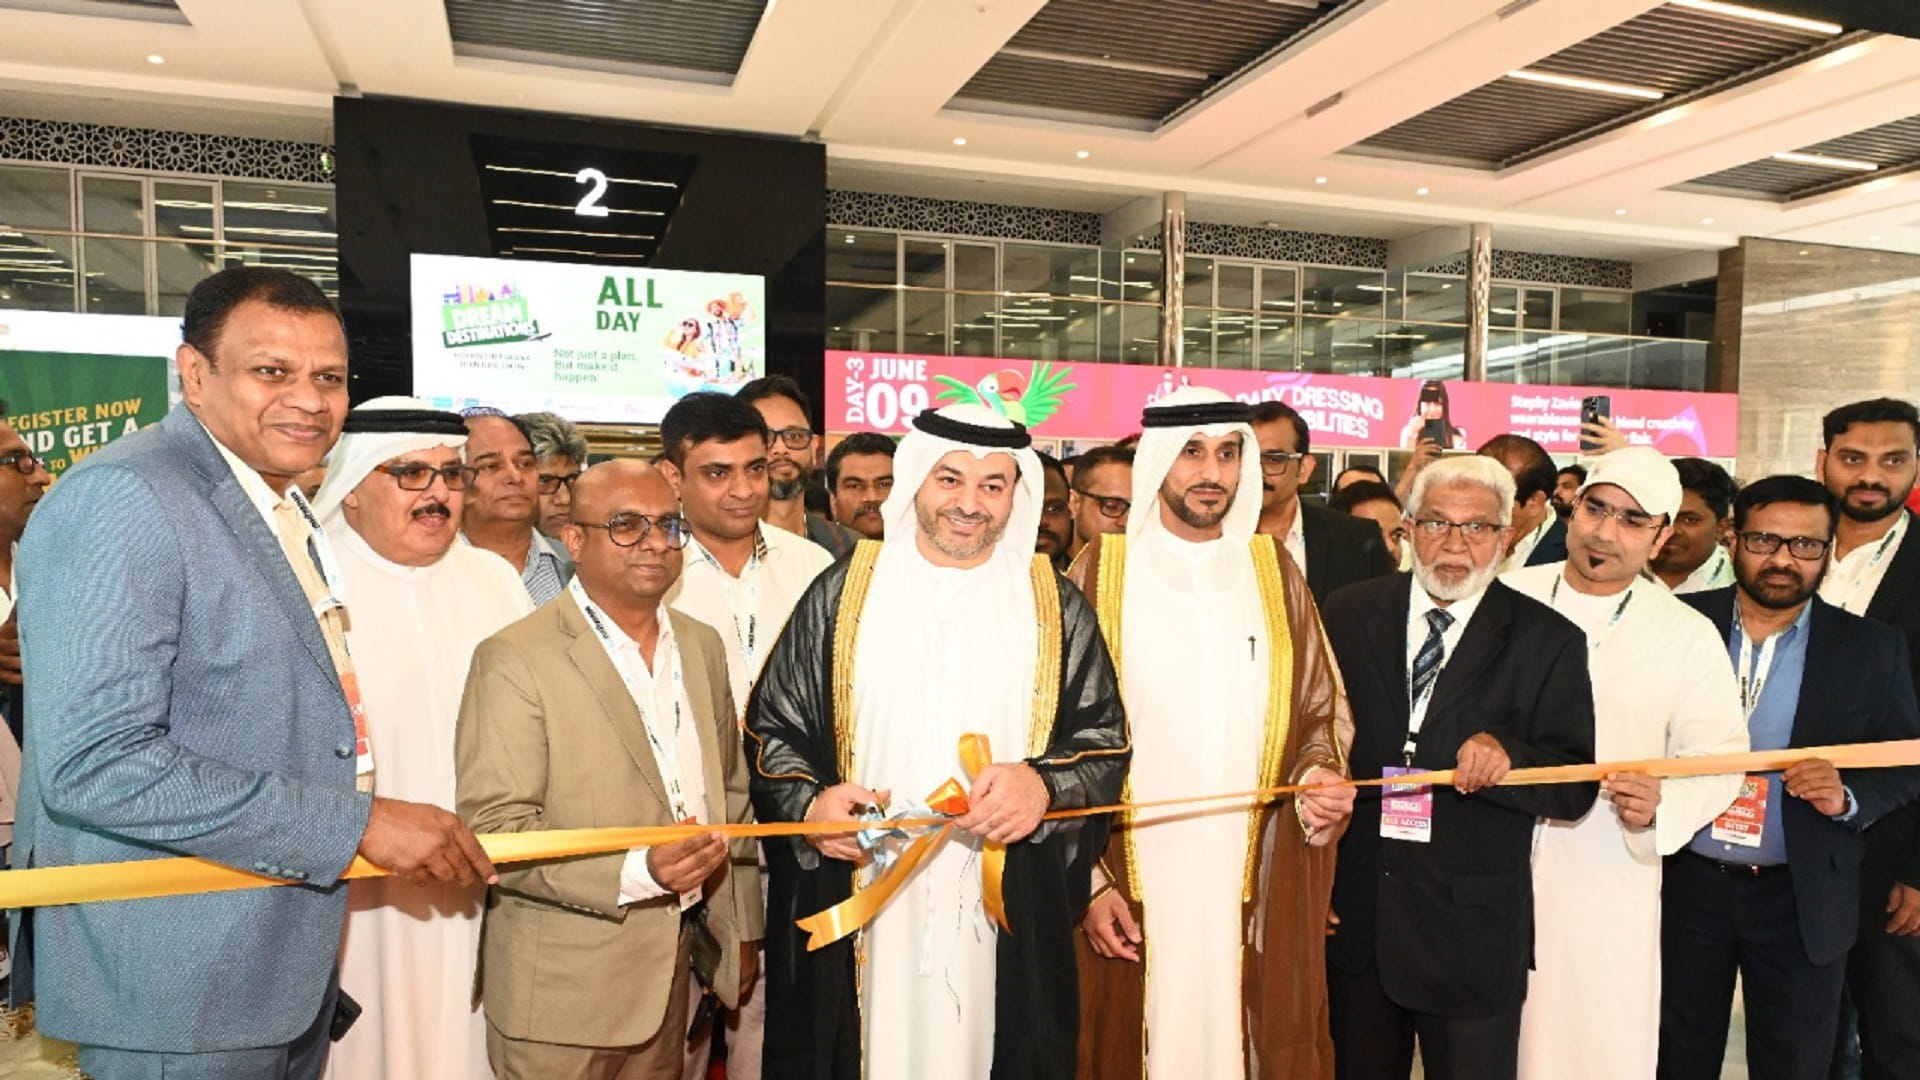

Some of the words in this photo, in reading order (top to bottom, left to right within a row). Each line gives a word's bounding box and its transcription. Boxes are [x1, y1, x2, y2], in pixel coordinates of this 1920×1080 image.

[575, 168, 609, 217] 2
[597, 276, 663, 308] ALL
[452, 302, 524, 330] DREAM
[597, 311, 640, 332] DAY
[554, 348, 573, 358] Not
[577, 349, 597, 361] just
[554, 360, 573, 369] But
[577, 361, 607, 371] make
[869, 358, 928, 381] JUNE
[846, 357, 864, 424] DAY-3
[866, 382, 929, 430] 09
[1291, 386, 1384, 421] DRESSING
[7, 406, 88, 431] EGISTER
[96, 398, 142, 420] NOW
[1300, 409, 1369, 439] BILITIES
[19, 430, 55, 453] ND
[63, 421, 112, 448] GET
[122, 417, 139, 436] A
[50, 458, 66, 470] TO
